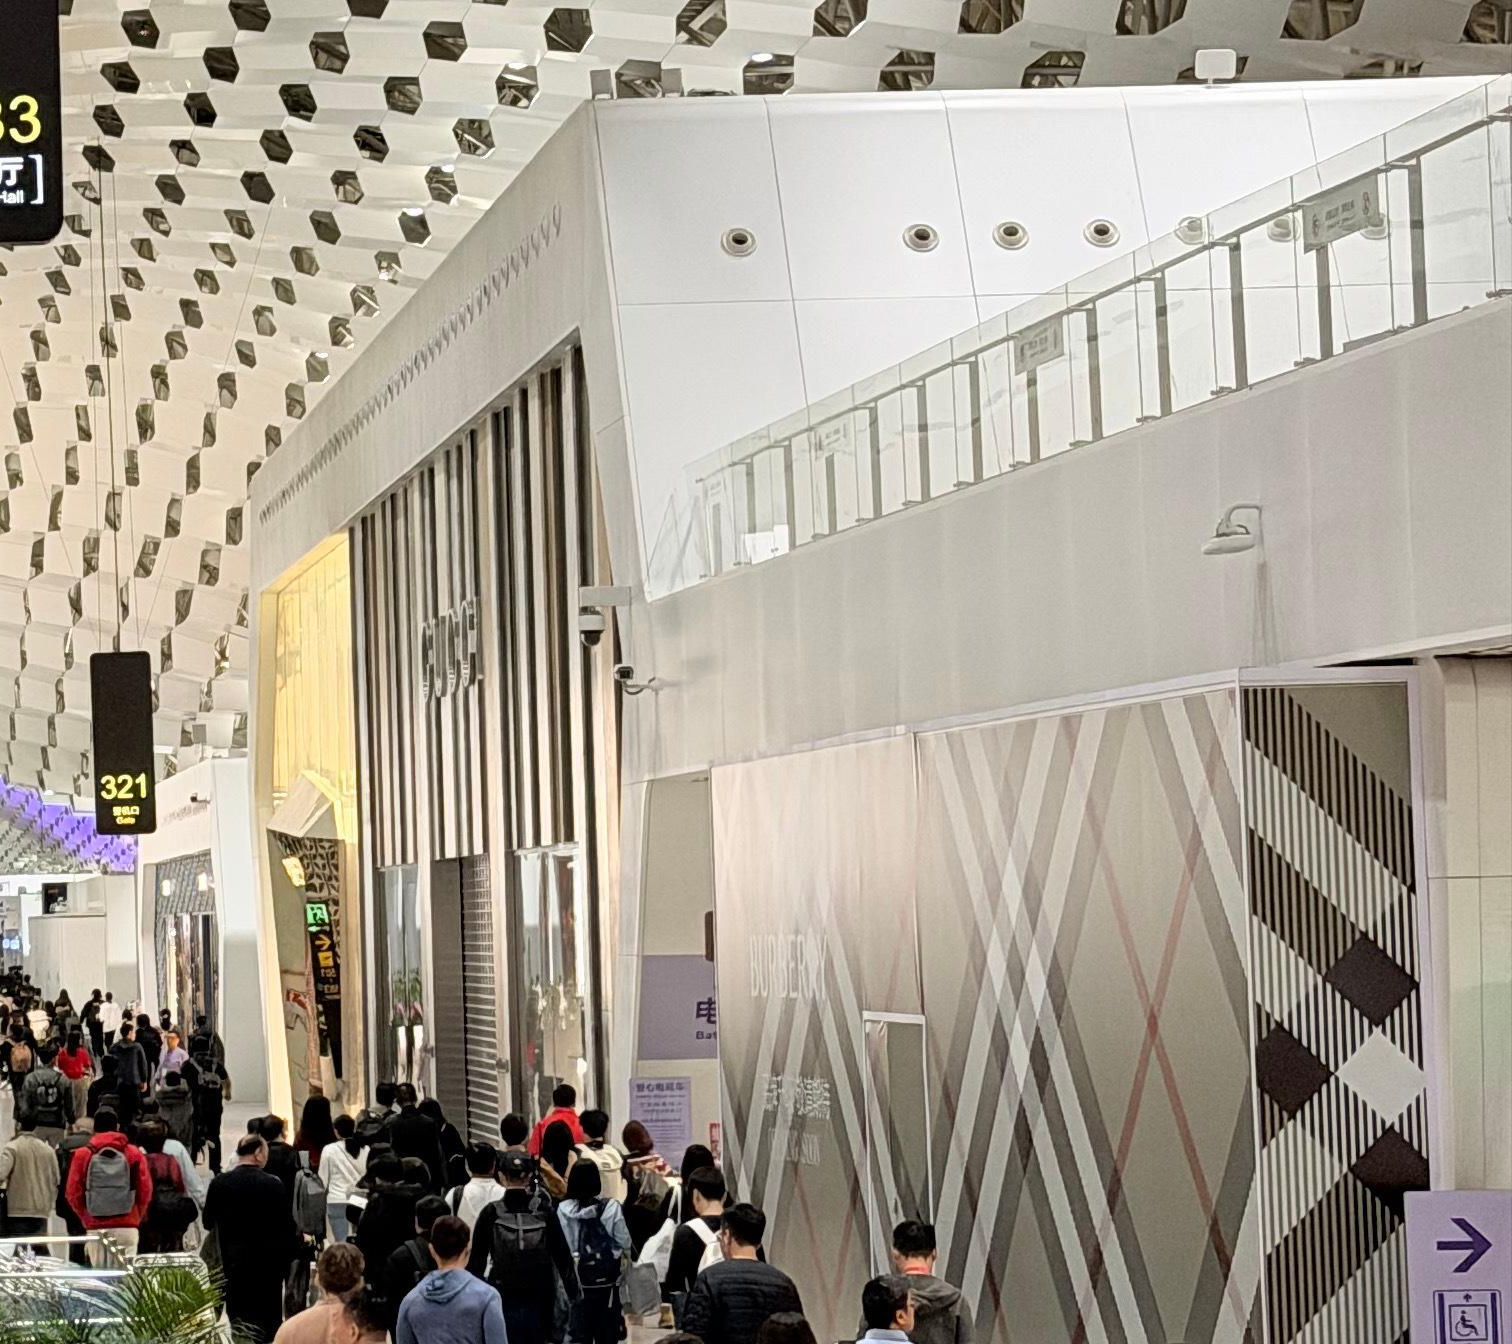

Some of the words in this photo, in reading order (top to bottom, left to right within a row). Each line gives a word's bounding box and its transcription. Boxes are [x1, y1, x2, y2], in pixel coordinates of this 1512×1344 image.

[100, 773, 148, 801] 321
[695, 996, 717, 1025] 电
[695, 1029, 717, 1040] Bat
